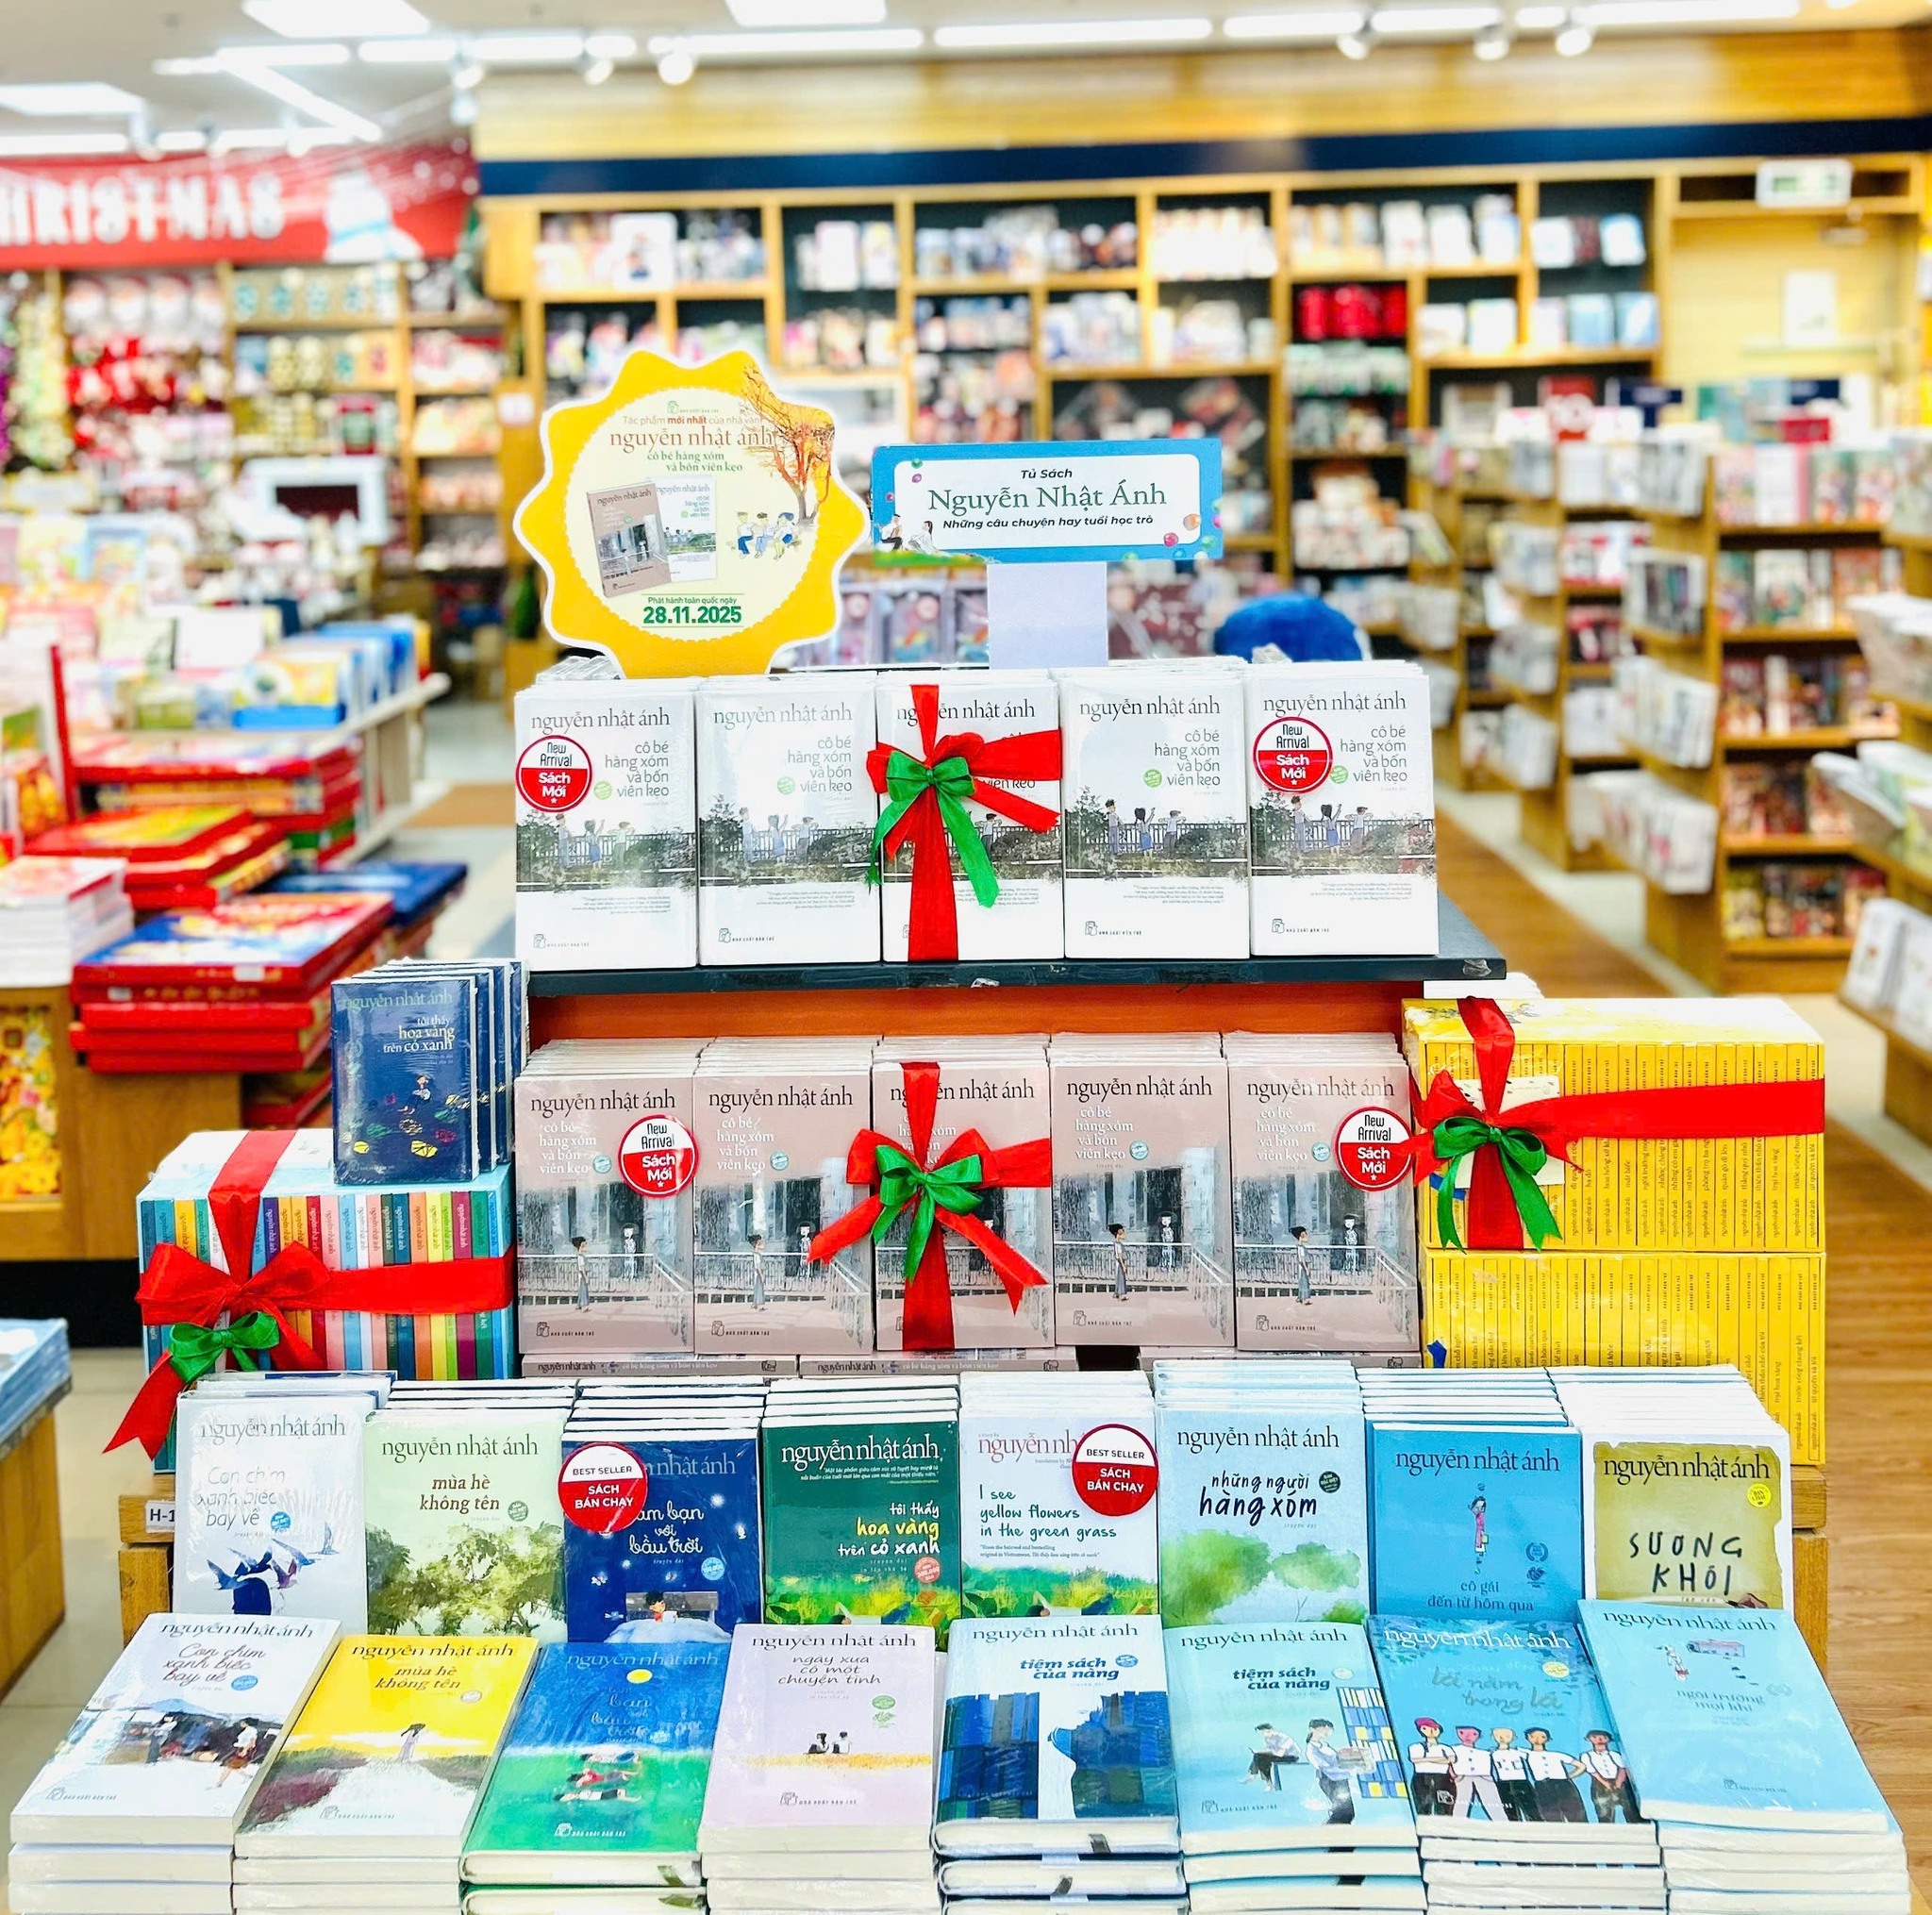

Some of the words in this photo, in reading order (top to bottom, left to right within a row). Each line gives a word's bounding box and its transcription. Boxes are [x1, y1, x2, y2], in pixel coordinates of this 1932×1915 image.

[668, 415, 685, 425] mới
[687, 415, 708, 425] nhất
[609, 427, 681, 454] nguyễn
[689, 425, 732, 449] nhật
[737, 425, 774, 446] ánh
[647, 451, 658, 460] cô
[661, 450, 674, 460] bé
[675, 451, 701, 463] hàng
[703, 452, 724, 460] xóm
[702, 462, 723, 472] viên
[1021, 469, 1036, 479] Tủ
[1040, 468, 1073, 479] Sách
[927, 487, 1029, 517] Nguyễn
[1036, 485, 1104, 511] Nhật
[1108, 479, 1167, 506] Ánh
[943, 516, 983, 530] Những
[986, 518, 1009, 528] câu
[1010, 517, 1056, 530] chuyện
[1058, 517, 1081, 528] hay
[1084, 516, 1108, 526] tuổi
[1111, 515, 1134, 527] học
[1136, 515, 1153, 525] trò
[643, 606, 741, 624] 28.11.2025
[531, 710, 593, 735] nguyễn
[598, 708, 636, 729] nhật
[640, 707, 671, 726] ánh
[547, 741, 566, 755] New
[635, 740, 652, 755] cô
[654, 740, 670, 753] bé
[540, 754, 573, 767] Arrival
[605, 755, 639, 772] hàng
[641, 755, 670, 768] xóm
[538, 769, 572, 784] Sách
[626, 770, 642, 784] và
[643, 769, 670, 784] bốn
[541, 784, 566, 798] Mới
[617, 783, 644, 798] viên
[647, 783, 670, 799] kẹo
[398, 1024, 424, 1040] hoa
[404, 1039, 420, 1053] cỏ
[423, 1039, 453, 1051] xanh
[1066, 1078, 1132, 1103] nguyễn
[1136, 1075, 1175, 1098] nhật
[1179, 1075, 1213, 1096] ánh
[530, 1092, 596, 1119] nguyễn
[600, 1090, 640, 1113] nhật
[642, 1089, 676, 1108] ánh
[1079, 1107, 1095, 1119] cô
[1096, 1106, 1112, 1118] bé
[647, 1123, 668, 1135] New
[1074, 1119, 1107, 1136] hàng
[1107, 1121, 1134, 1132] xóm
[641, 1135, 675, 1149] Arrival
[1077, 1135, 1093, 1146] và
[1094, 1132, 1118, 1146] bốn
[641, 1155, 675, 1168] Sách
[1075, 1147, 1102, 1160] viên
[1103, 1147, 1126, 1162] kẹo
[647, 1168, 674, 1182] Mới
[1177, 1427, 1249, 1454] nguyễn
[1255, 1424, 1299, 1450] nhật
[1302, 1424, 1340, 1449] ánh
[381, 1439, 451, 1464] nguyễn
[457, 1434, 498, 1458] nhật
[502, 1432, 539, 1456] ánh
[782, 1440, 855, 1472] nguyễn
[856, 1434, 900, 1464] nhật
[902, 1433, 940, 1459] ánh
[977, 1432, 1049, 1463] nguyễn
[1087, 1449, 1109, 1457] BEST
[1111, 1449, 1145, 1460] SELLER
[658, 1453, 698, 1478] nhật
[701, 1452, 737, 1475] ánh
[1396, 1449, 1470, 1477] nguyễn
[1474, 1447, 1521, 1473] nhật
[1523, 1448, 1560, 1472] ánh
[1604, 1457, 1680, 1485] nguyễn
[1683, 1454, 1728, 1481] nhật
[1730, 1452, 1770, 1479] ánh
[573, 1468, 596, 1476] BEST
[598, 1466, 632, 1475] SELLER
[1100, 1467, 1130, 1479] SÁCH
[432, 1474, 466, 1490] mùa
[472, 1474, 491, 1490] hè
[588, 1483, 619, 1495] SÁCH
[1087, 1477, 1110, 1490] BÁN
[1113, 1481, 1144, 1495] CHẠY
[1211, 1471, 1262, 1490] những
[1266, 1473, 1309, 1492] người
[979, 1484, 983, 1500] I
[991, 1490, 1017, 1500] see
[420, 1494, 469, 1514] không
[475, 1496, 500, 1510] tên
[575, 1496, 600, 1509] BÁN
[602, 1496, 634, 1509] CHẠY
[889, 1502, 906, 1515] tôi
[910, 1500, 940, 1518] thấy
[1200, 1487, 1266, 1526] hàng
[1270, 1489, 1318, 1517] xóm
[666, 1500, 704, 1524] bạn
[979, 1504, 1022, 1523] yellow
[1028, 1504, 1081, 1519] flowers
[857, 1517, 891, 1536] hoa
[896, 1518, 940, 1541] vàng
[980, 1524, 992, 1537] in
[998, 1523, 1024, 1537] the
[1030, 1525, 1070, 1541] green
[1076, 1526, 1117, 1542] grass
[628, 1534, 668, 1555] bầu
[668, 1536, 704, 1554] trời
[838, 1543, 866, 1557] trên
[870, 1538, 890, 1555] cỏ
[894, 1534, 941, 1555] xanh
[1630, 1530, 1743, 1560] SƯƠNG
[1460, 1581, 1477, 1592] cô
[1479, 1579, 1500, 1595] gái
[1653, 1562, 1732, 1596] KHÓI
[1426, 1594, 1454, 1608] đến
[1455, 1596, 1471, 1609] từ
[1474, 1596, 1506, 1610] hôm
[1508, 1601, 1534, 1613] qua
[1052, 1624, 1097, 1639] nhật
[1100, 1624, 1139, 1637] ánh
[394, 1666, 431, 1675] mùa
[435, 1665, 458, 1676] hè
[1020, 1658, 1062, 1672] tiệm
[1067, 1657, 1107, 1668] sách
[1033, 1668, 1067, 1679] của
[1072, 1668, 1120, 1681] nàng
[375, 1677, 430, 1690] không
[433, 1679, 462, 1689] tên
